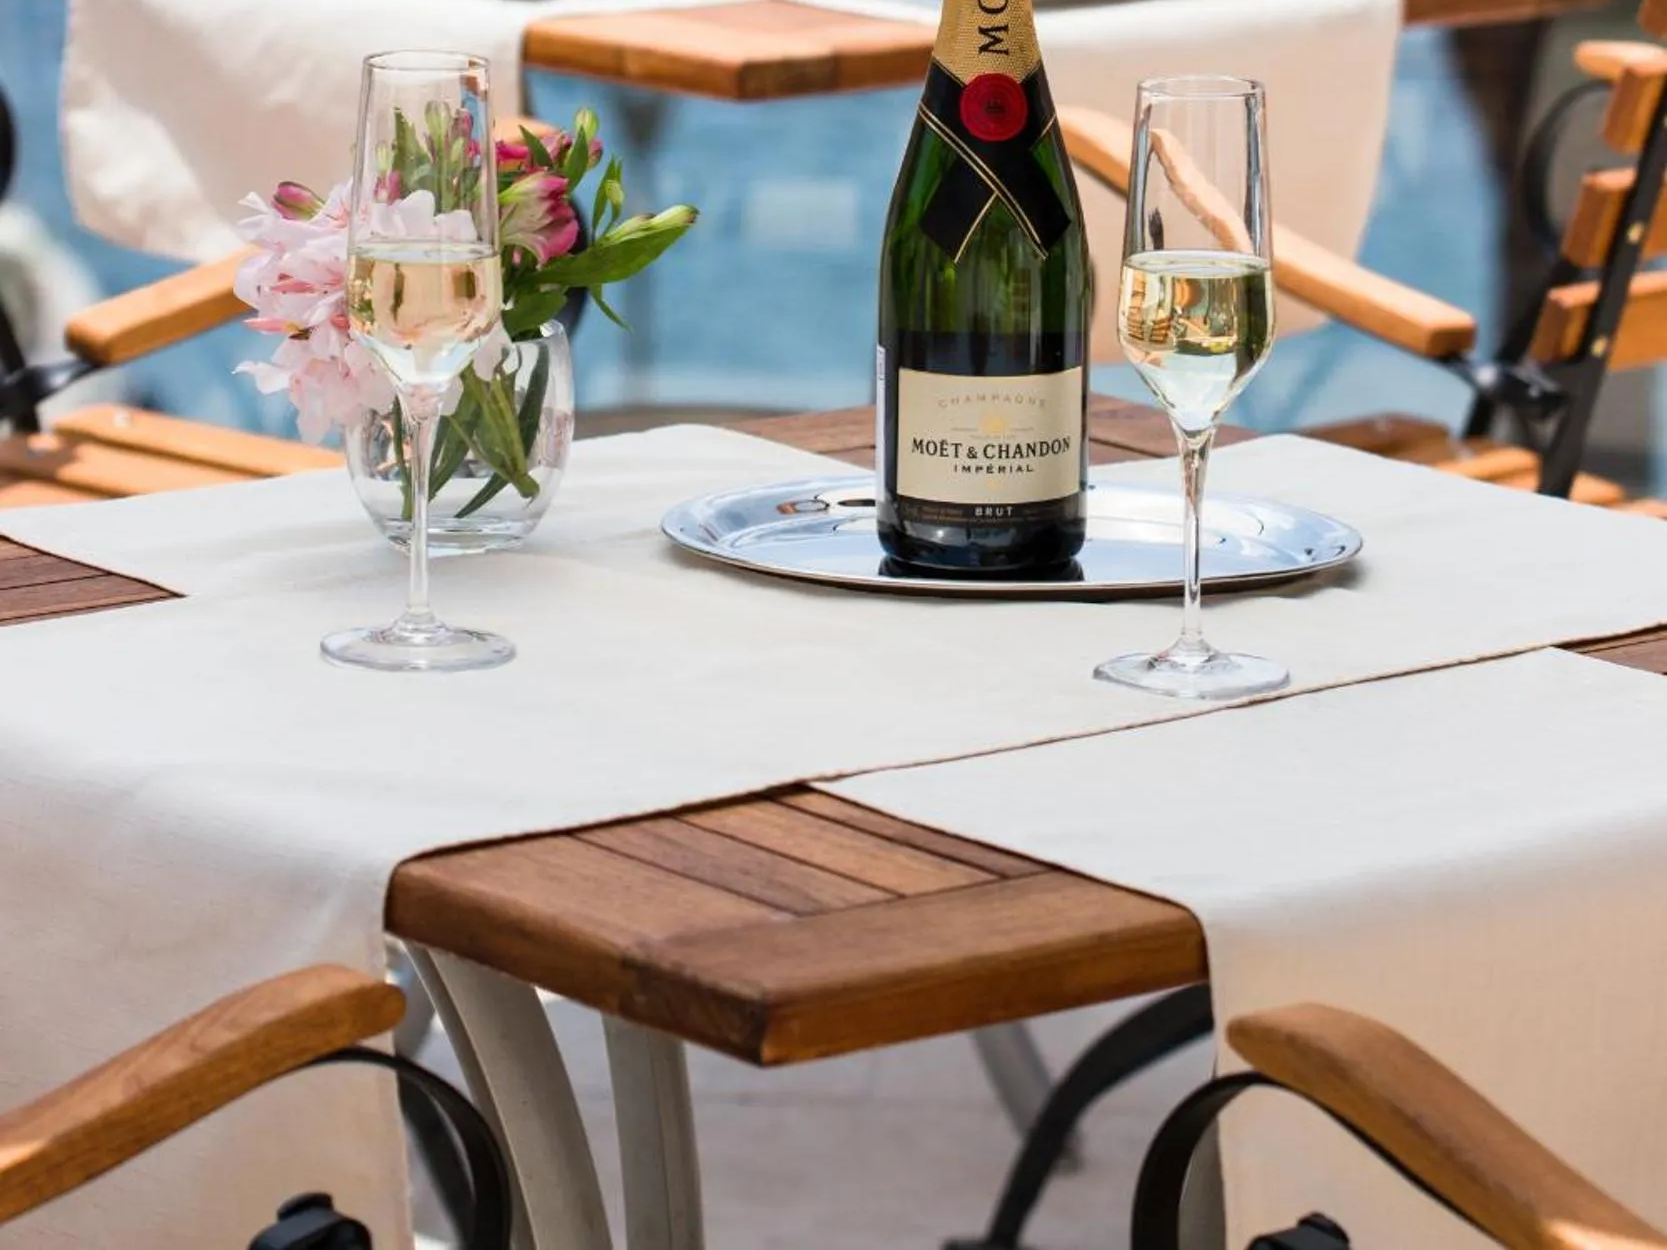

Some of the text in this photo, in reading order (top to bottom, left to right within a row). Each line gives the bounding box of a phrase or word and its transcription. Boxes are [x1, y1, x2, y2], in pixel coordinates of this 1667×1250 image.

[938, 393, 1047, 409] CHAMPAGNE
[911, 436, 1071, 459] MOËT & CHANDON
[954, 463, 1034, 474] IMPÉRIAL
[974, 506, 1014, 517] BRUT
